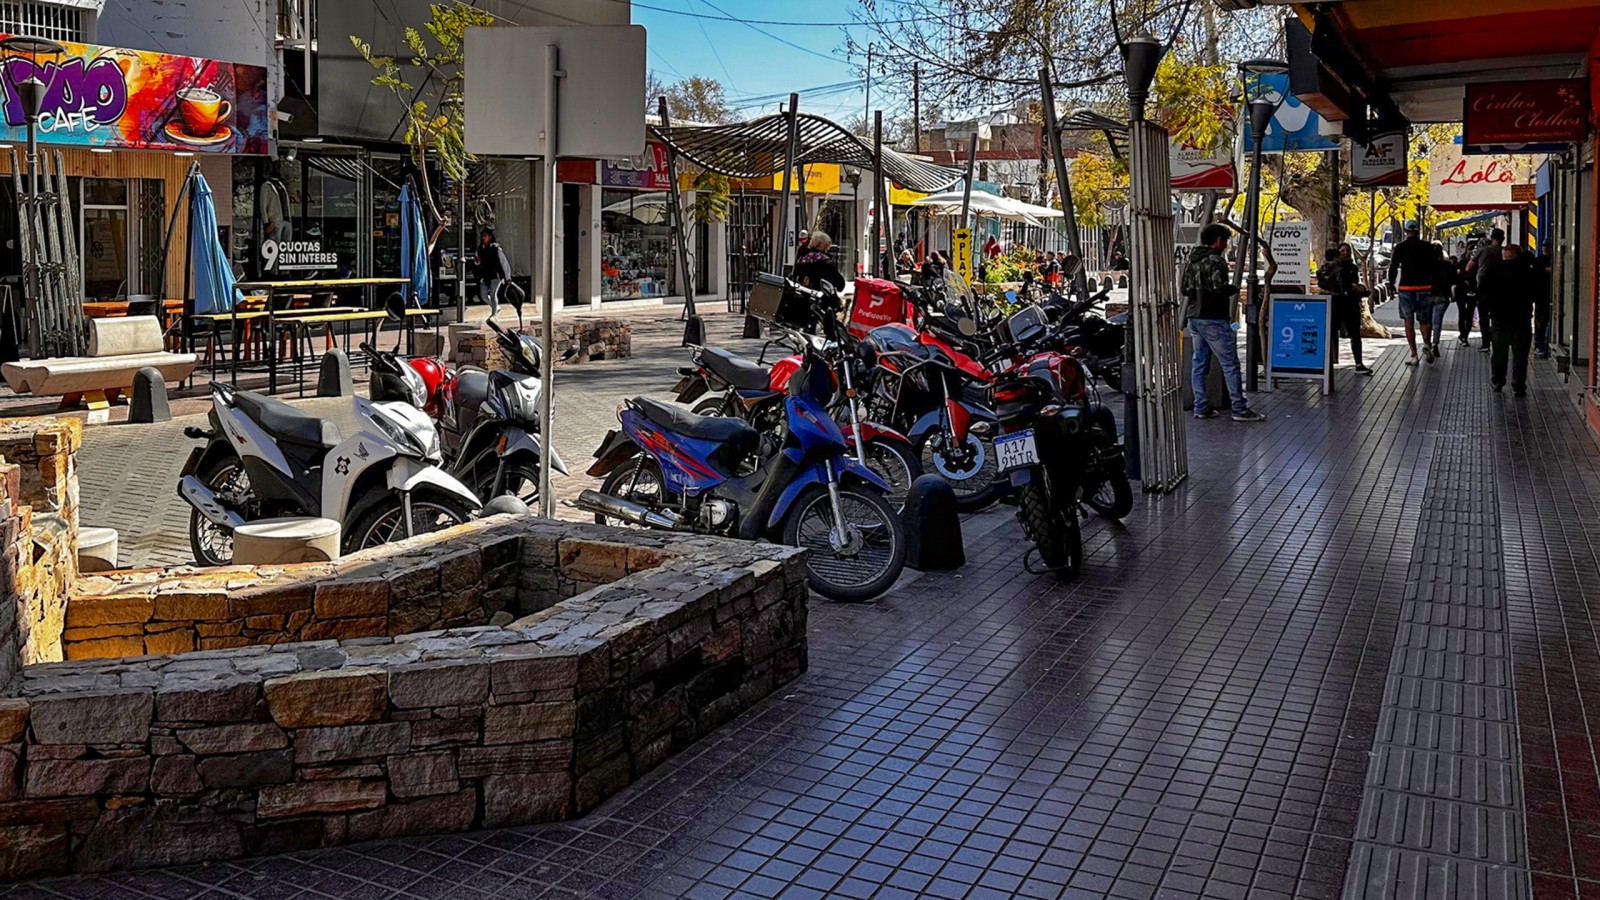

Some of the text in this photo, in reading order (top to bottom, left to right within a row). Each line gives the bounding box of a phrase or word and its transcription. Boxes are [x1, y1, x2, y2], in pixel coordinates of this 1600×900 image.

[1440, 159, 1514, 186] Lola
[1273, 230, 1301, 238] CUYO
[261, 239, 279, 271] 9
[279, 241, 320, 252] CUOTAS
[279, 253, 297, 264] SIN
[857, 308, 892, 322] PedidosYa
[1281, 326, 1295, 344] 9
[1003, 438, 1027, 456] A17
